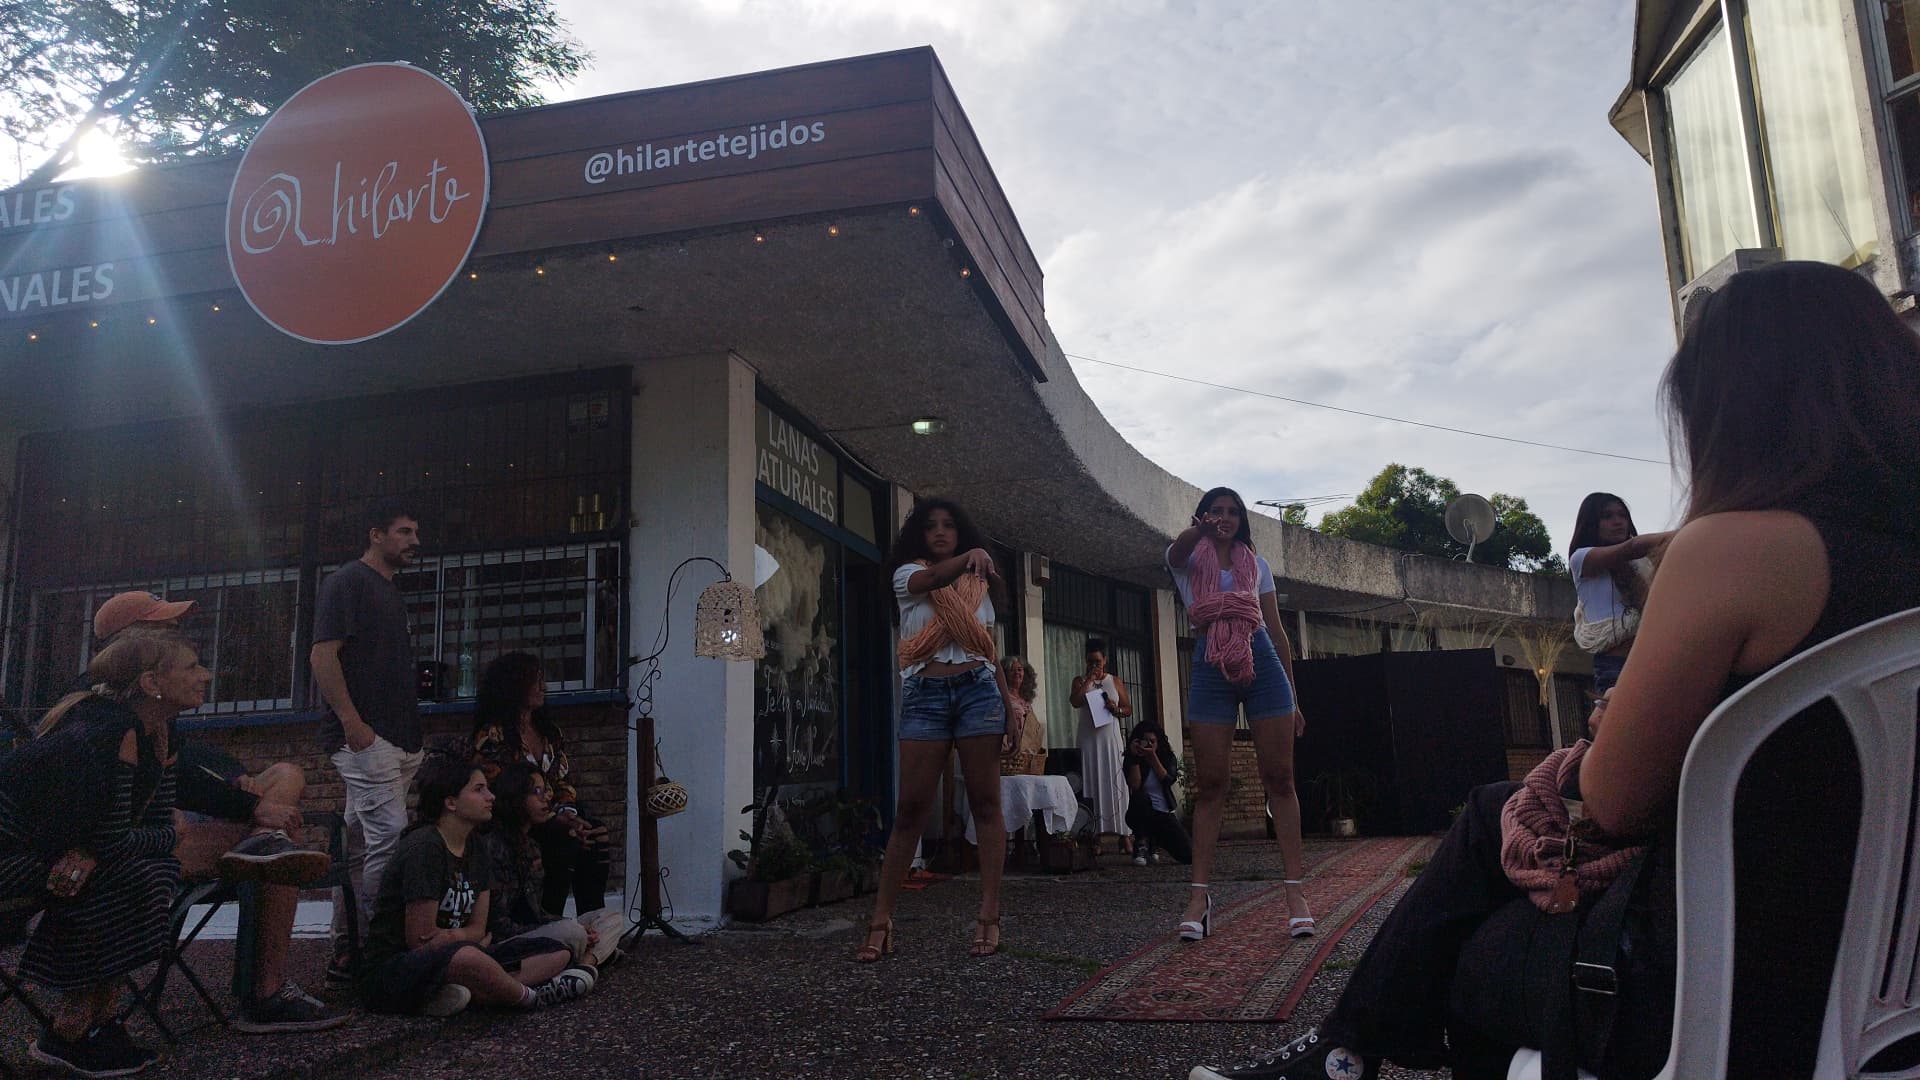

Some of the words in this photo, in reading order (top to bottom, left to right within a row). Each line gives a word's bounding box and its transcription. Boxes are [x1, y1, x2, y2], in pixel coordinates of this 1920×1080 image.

[584, 119, 826, 185] @hilartetejidos
[768, 409, 819, 476] LANAS
[758, 448, 835, 522] ATURALES
